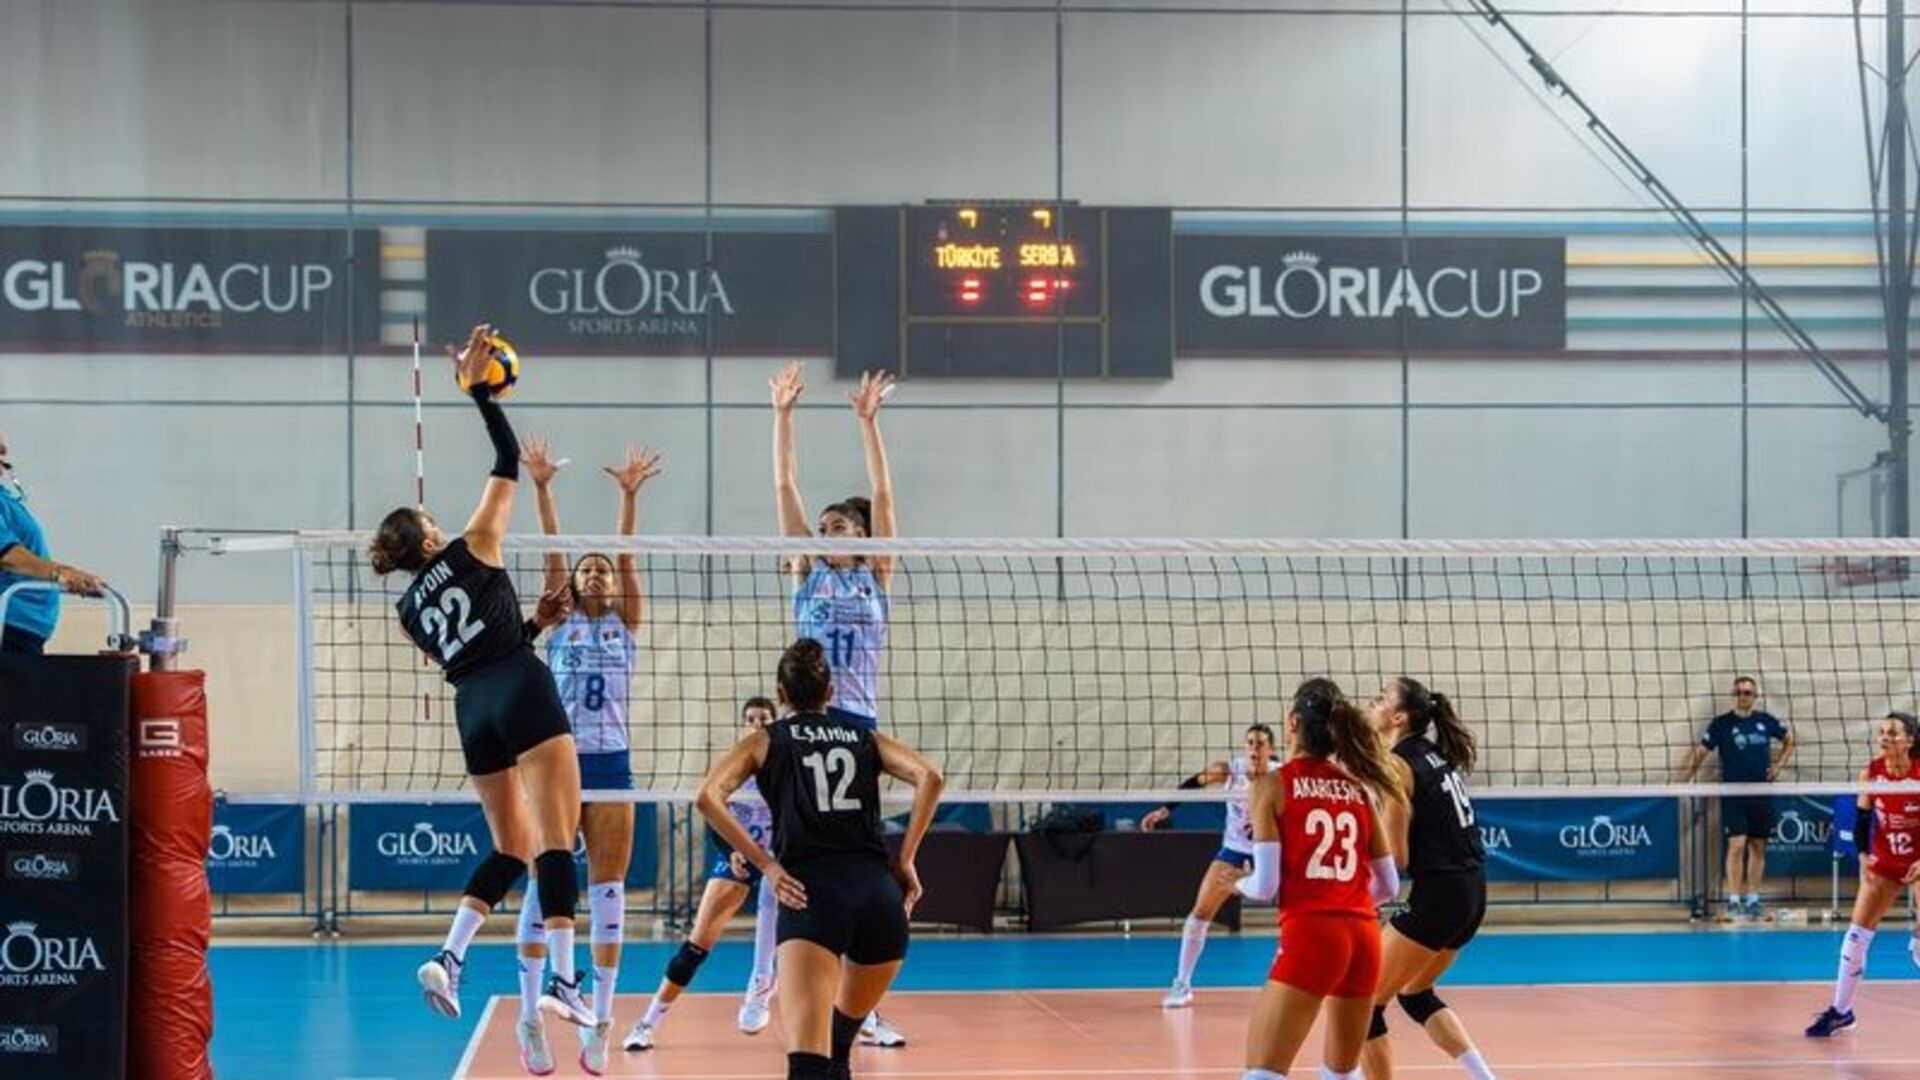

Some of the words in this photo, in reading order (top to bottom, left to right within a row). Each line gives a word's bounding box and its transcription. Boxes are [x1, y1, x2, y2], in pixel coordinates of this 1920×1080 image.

[1019, 244, 1076, 266] SERBA
[529, 258, 735, 316] GLORIA
[568, 319, 632, 335] SPORTS
[639, 319, 698, 335] ARENA
[420, 586, 486, 662] 22
[825, 626, 855, 667] 11
[585, 675, 605, 711] 8
[23, 729, 78, 745] GLORIA
[802, 747, 862, 812] 12
[46, 822, 92, 836] ARENA
[377, 829, 477, 856] GLORIA
[1559, 821, 1652, 848] GLORIA
[1305, 808, 1358, 881] 23
[1885, 832, 1914, 855] 12
[14, 859, 69, 875] GLORIA
[31, 973, 77, 985] ARENA
